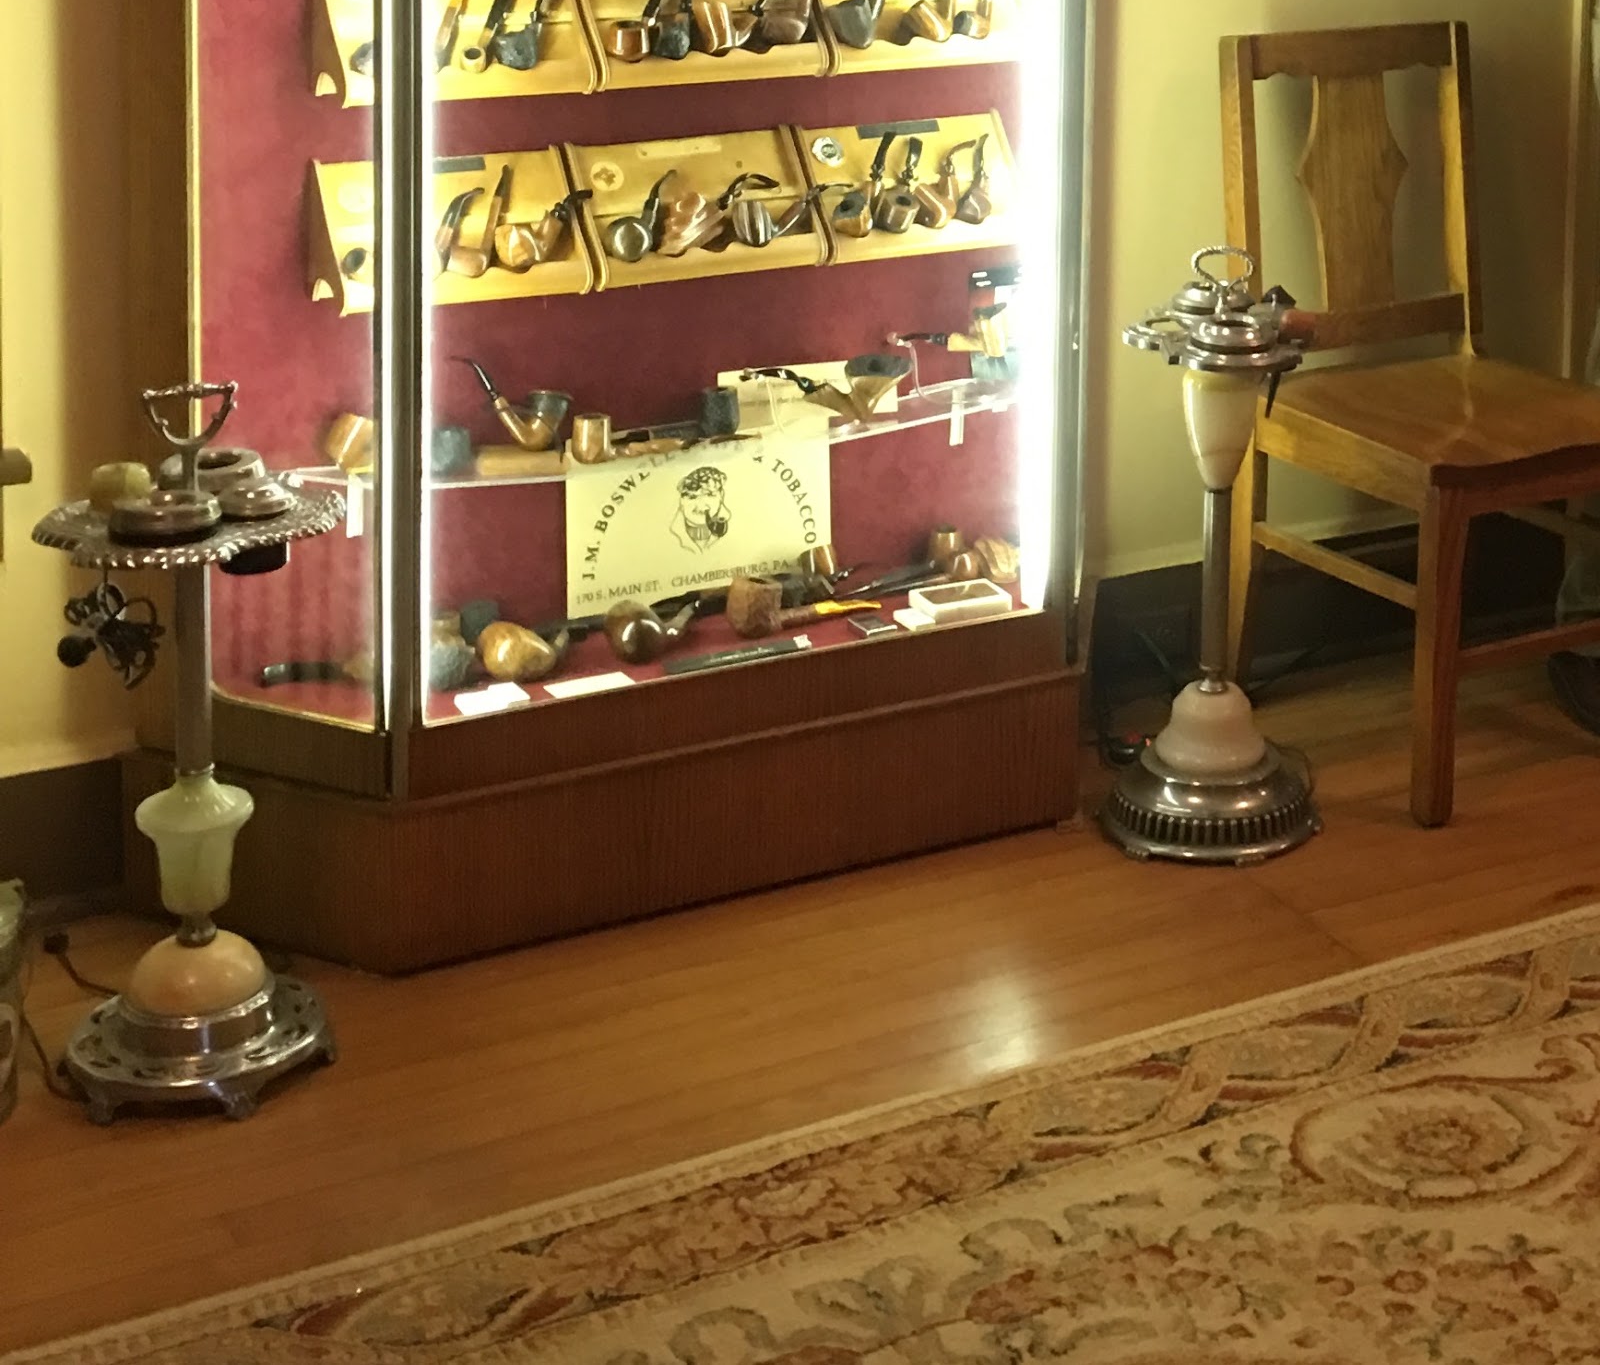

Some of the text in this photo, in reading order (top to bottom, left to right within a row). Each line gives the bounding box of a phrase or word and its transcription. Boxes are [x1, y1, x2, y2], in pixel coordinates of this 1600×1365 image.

[771, 458, 817, 544] TOBACCO
[576, 592, 594, 605] 170
[608, 583, 642, 599] MAIN
